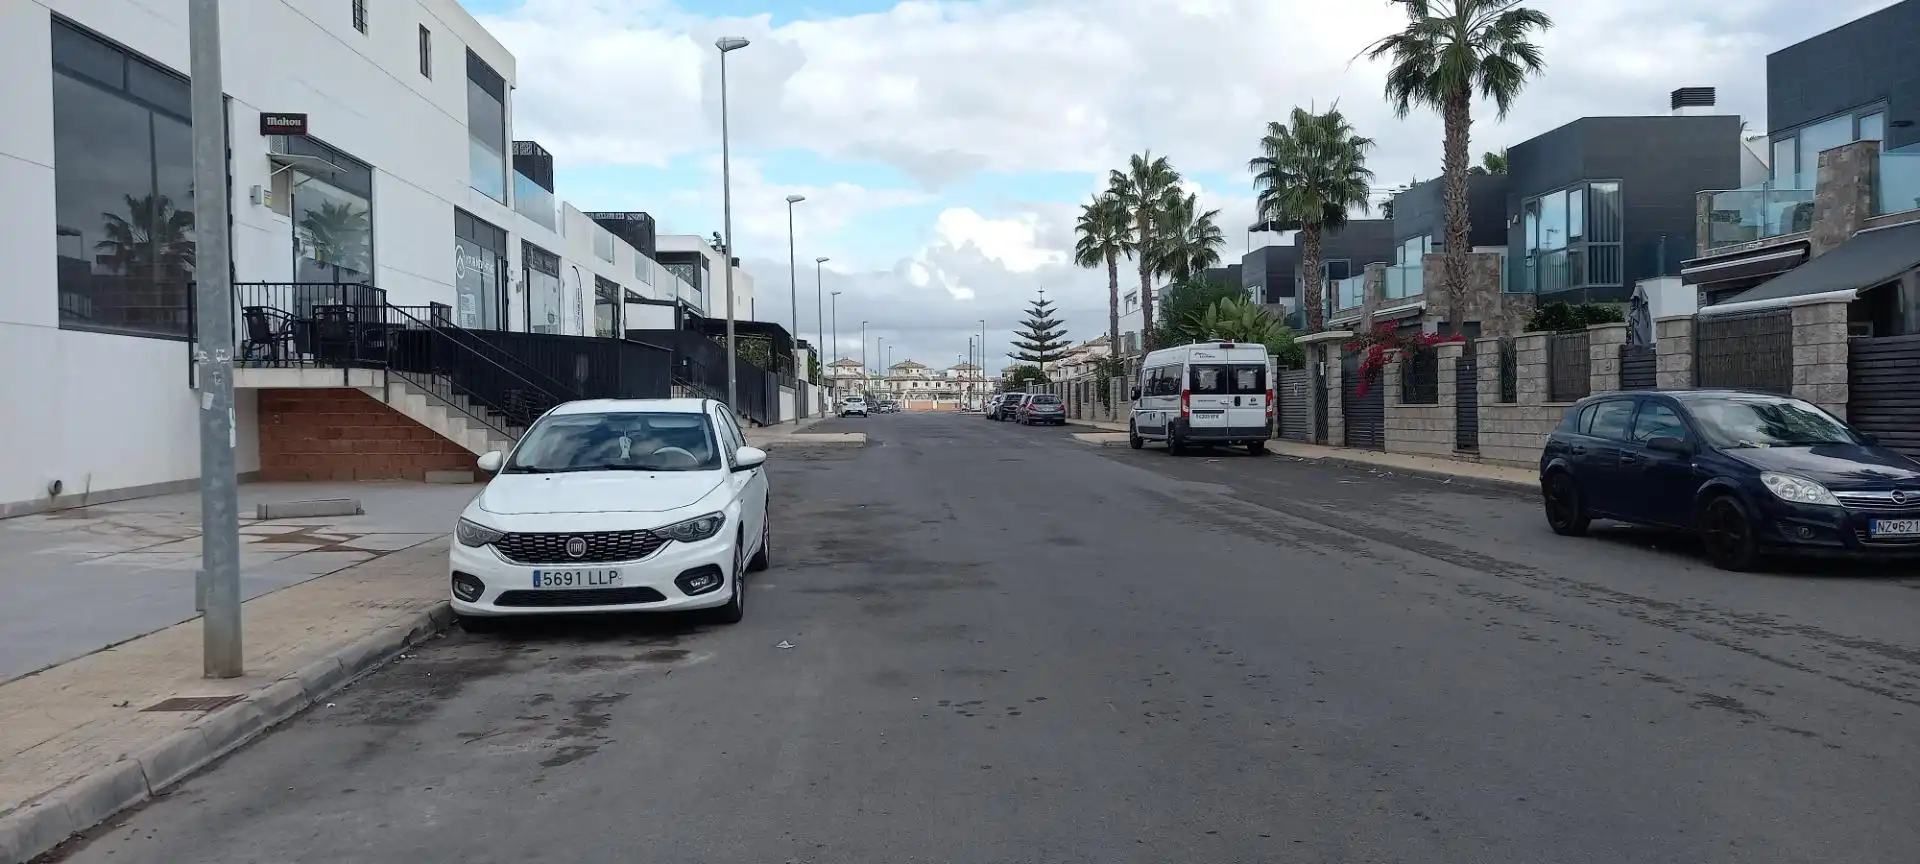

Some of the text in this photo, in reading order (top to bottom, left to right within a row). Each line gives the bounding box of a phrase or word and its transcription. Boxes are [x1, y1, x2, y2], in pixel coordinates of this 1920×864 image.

[266, 117, 302, 126] Mahou
[570, 542, 583, 552] FIAT
[543, 570, 618, 586] 5691 LLP
